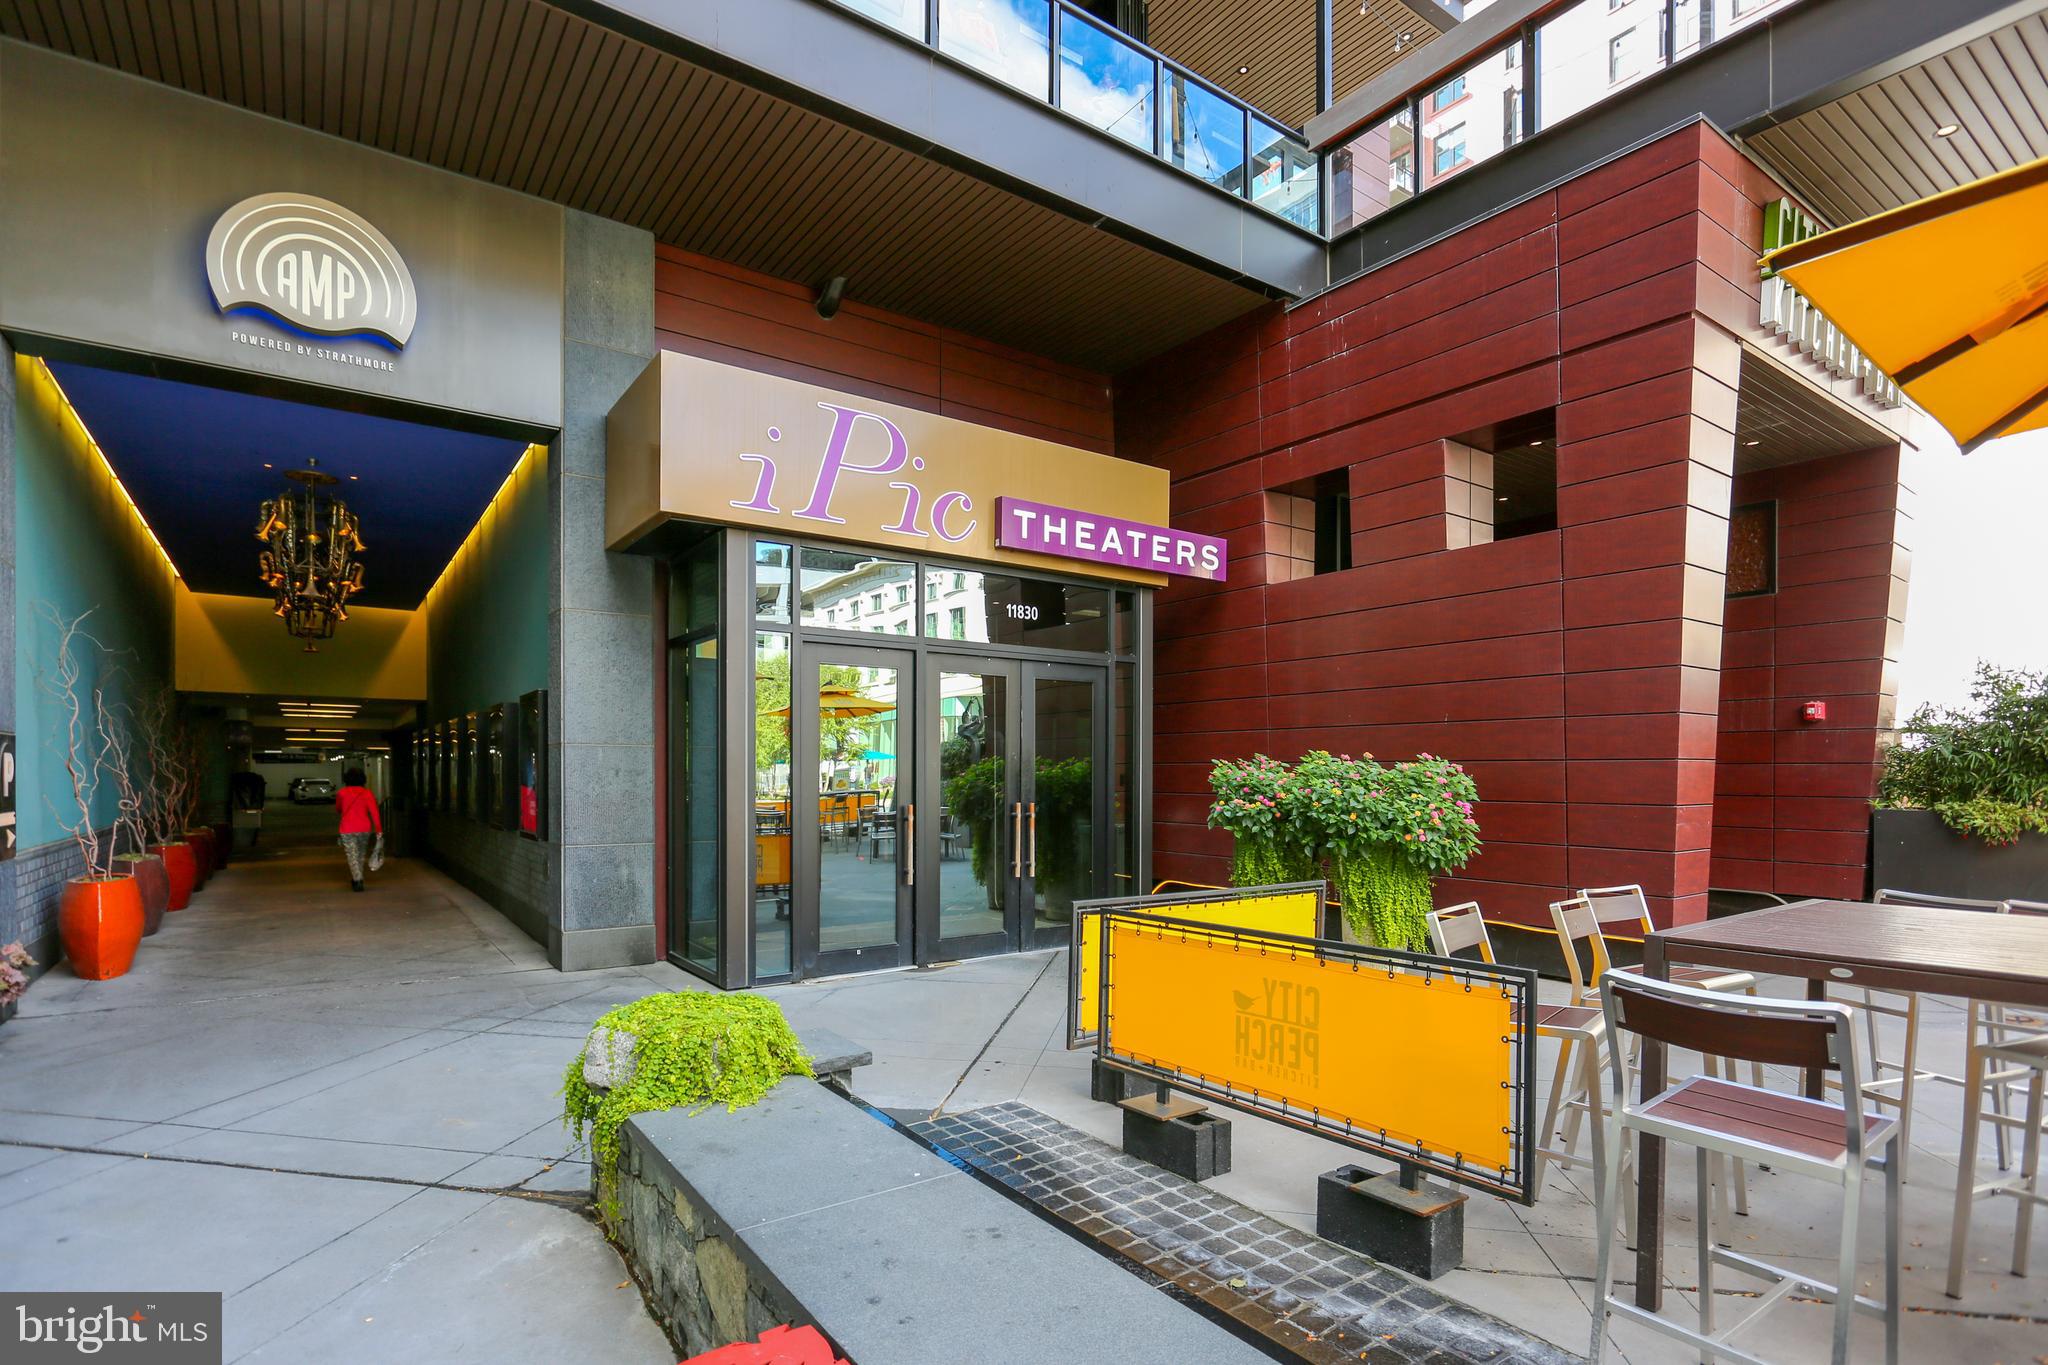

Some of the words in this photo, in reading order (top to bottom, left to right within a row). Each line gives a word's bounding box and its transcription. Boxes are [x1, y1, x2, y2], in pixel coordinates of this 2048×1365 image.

[277, 250, 355, 320] AMP
[232, 331, 291, 352] POWERED
[297, 344, 311, 356] BY
[317, 348, 394, 372] STRATHMORE
[729, 401, 977, 542] iPic
[1013, 509, 1220, 571] THEATERS
[1006, 603, 1039, 621] 11830
